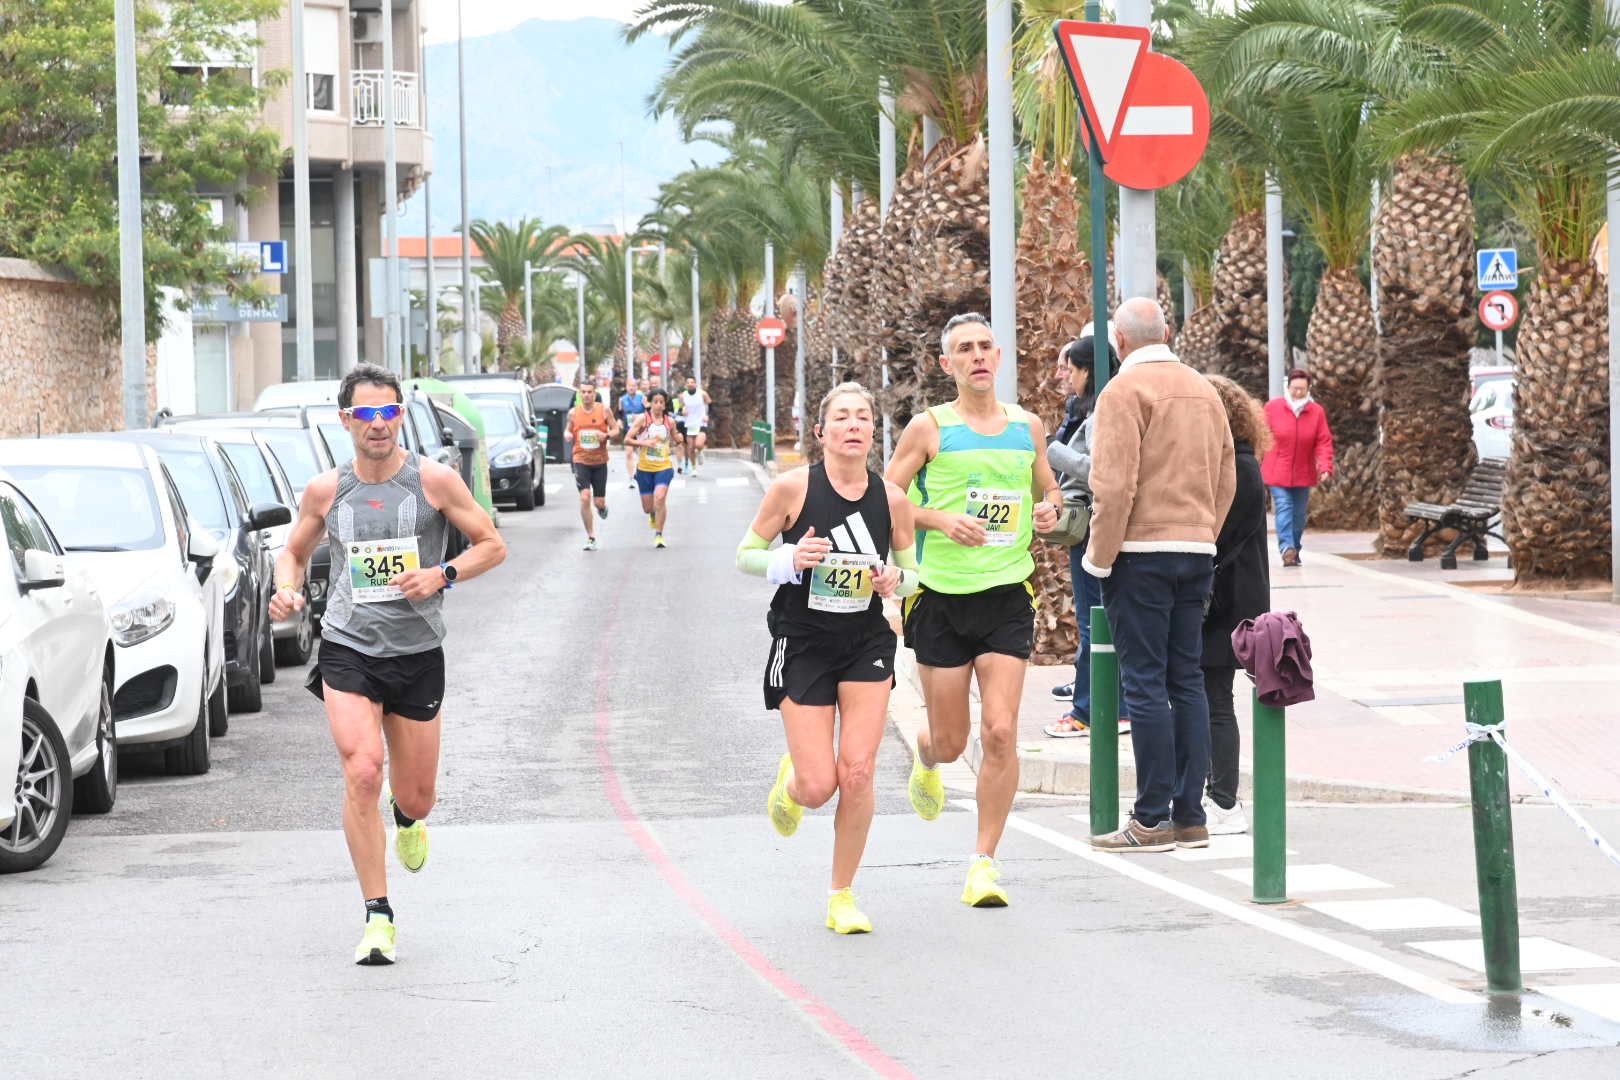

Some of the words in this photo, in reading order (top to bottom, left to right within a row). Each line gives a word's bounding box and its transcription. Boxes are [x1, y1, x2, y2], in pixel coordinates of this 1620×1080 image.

[263, 244, 281, 269] L
[239, 309, 279, 318] DENTAL
[977, 503, 1010, 523] 422
[363, 554, 405, 578] 345
[824, 568, 863, 590] 421
